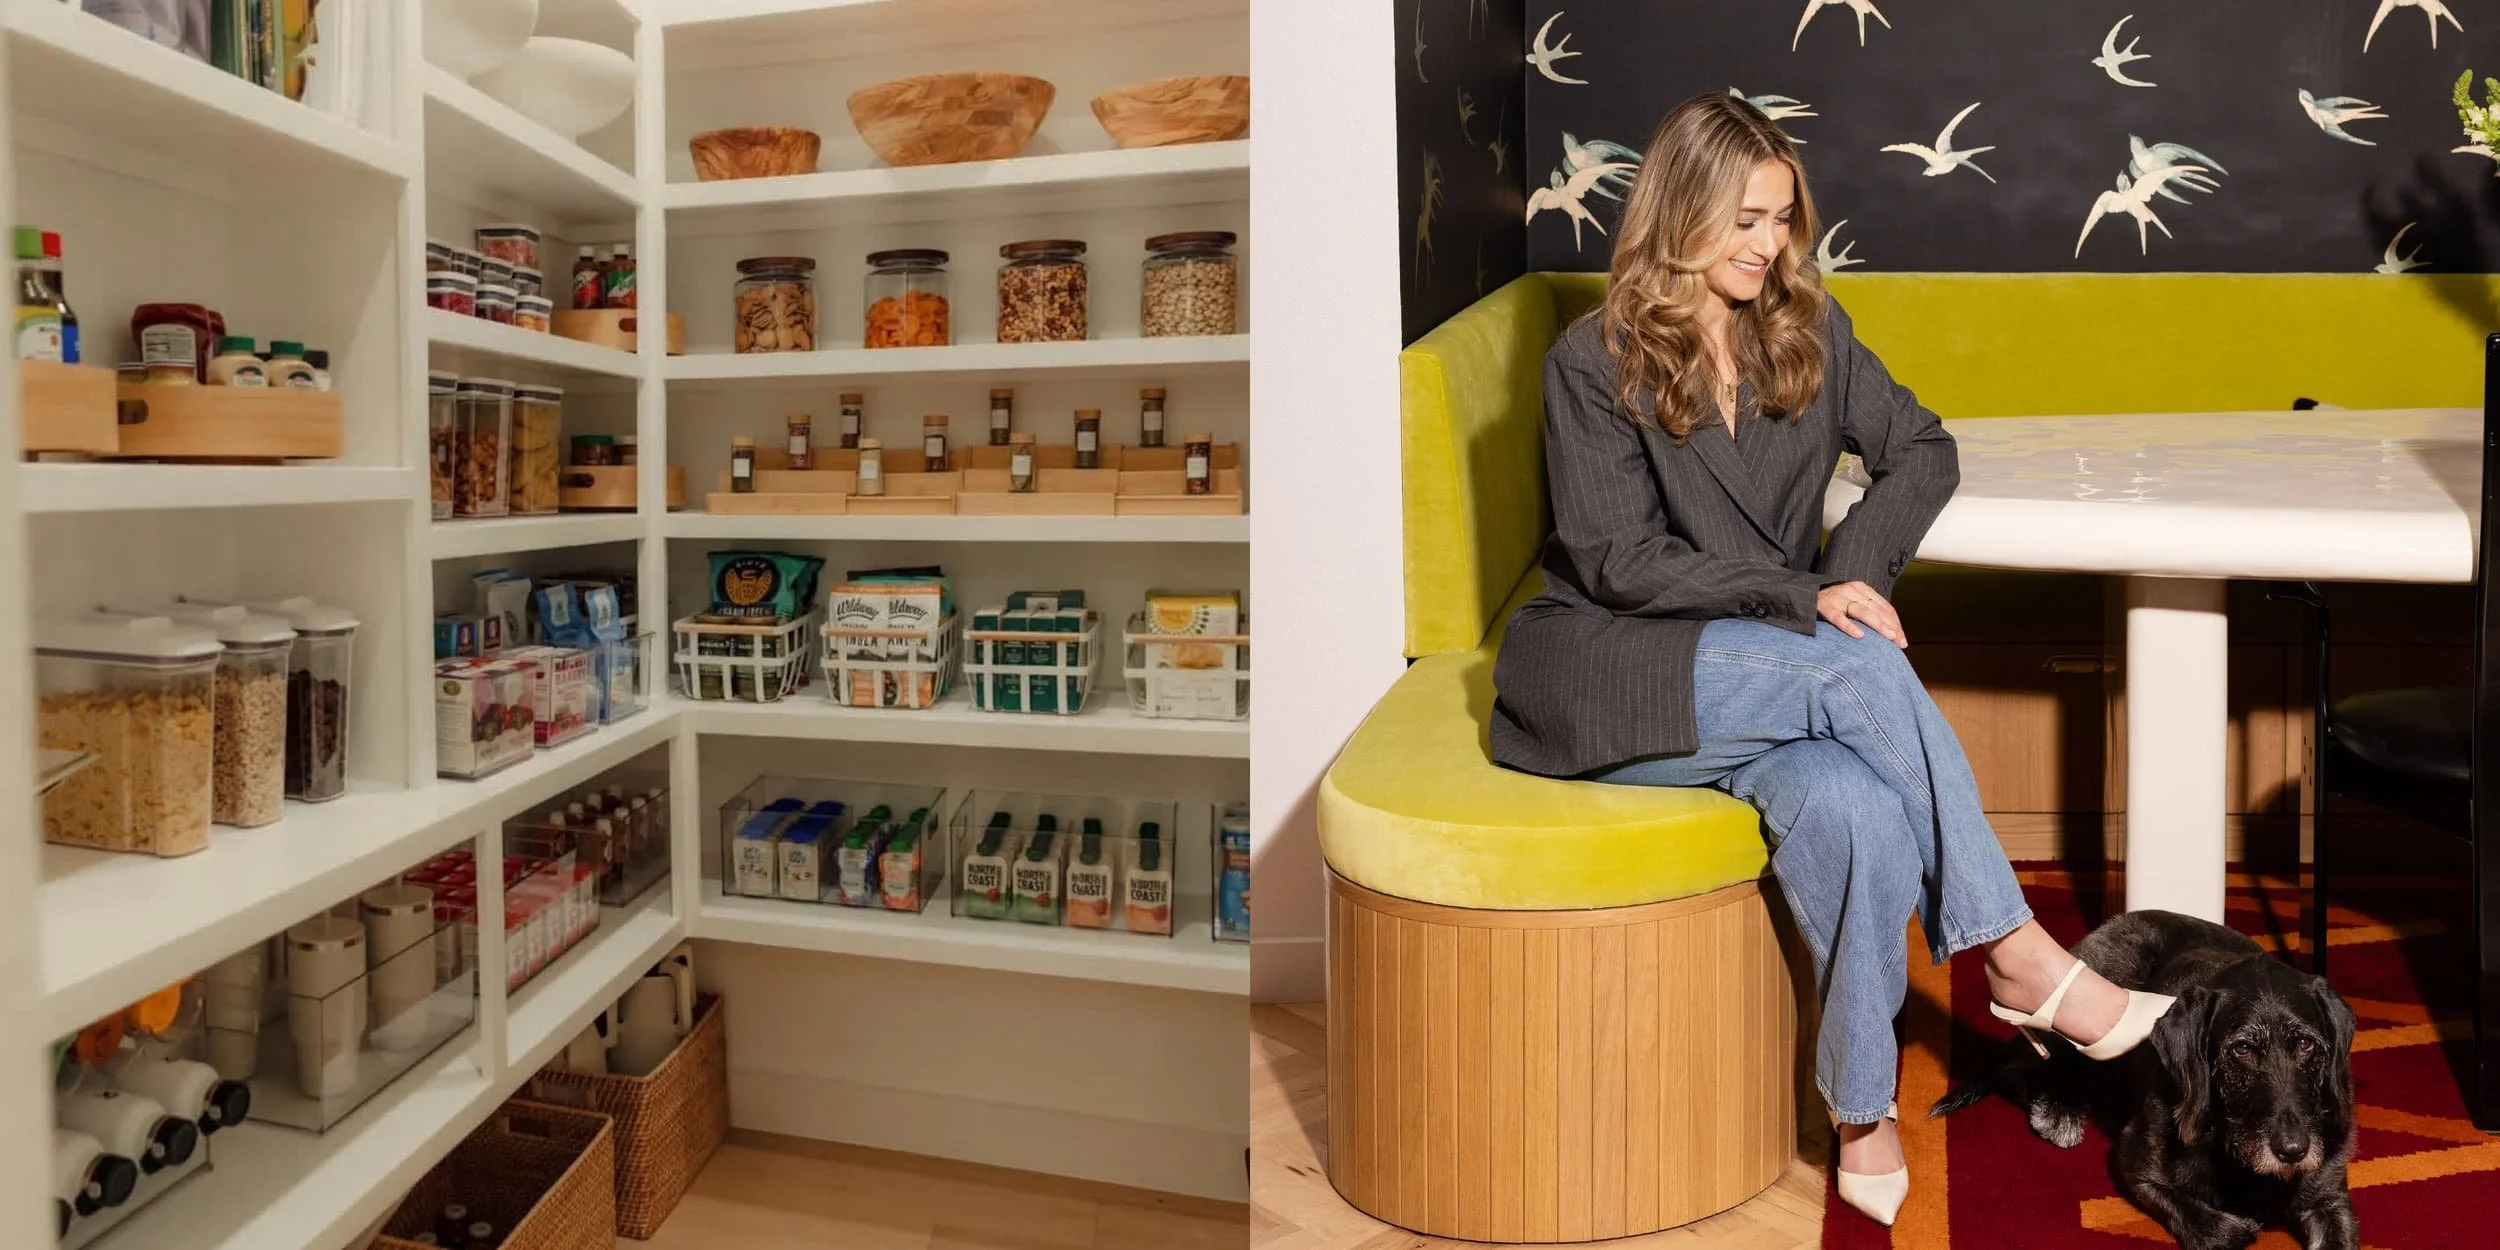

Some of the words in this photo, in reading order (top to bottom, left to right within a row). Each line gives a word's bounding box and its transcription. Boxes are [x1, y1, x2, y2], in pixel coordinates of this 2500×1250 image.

[968, 874, 995, 886] COAST
[1017, 879, 1044, 892] COAST
[1072, 883, 1100, 896] COAST
[1131, 889, 1160, 902] COAST
